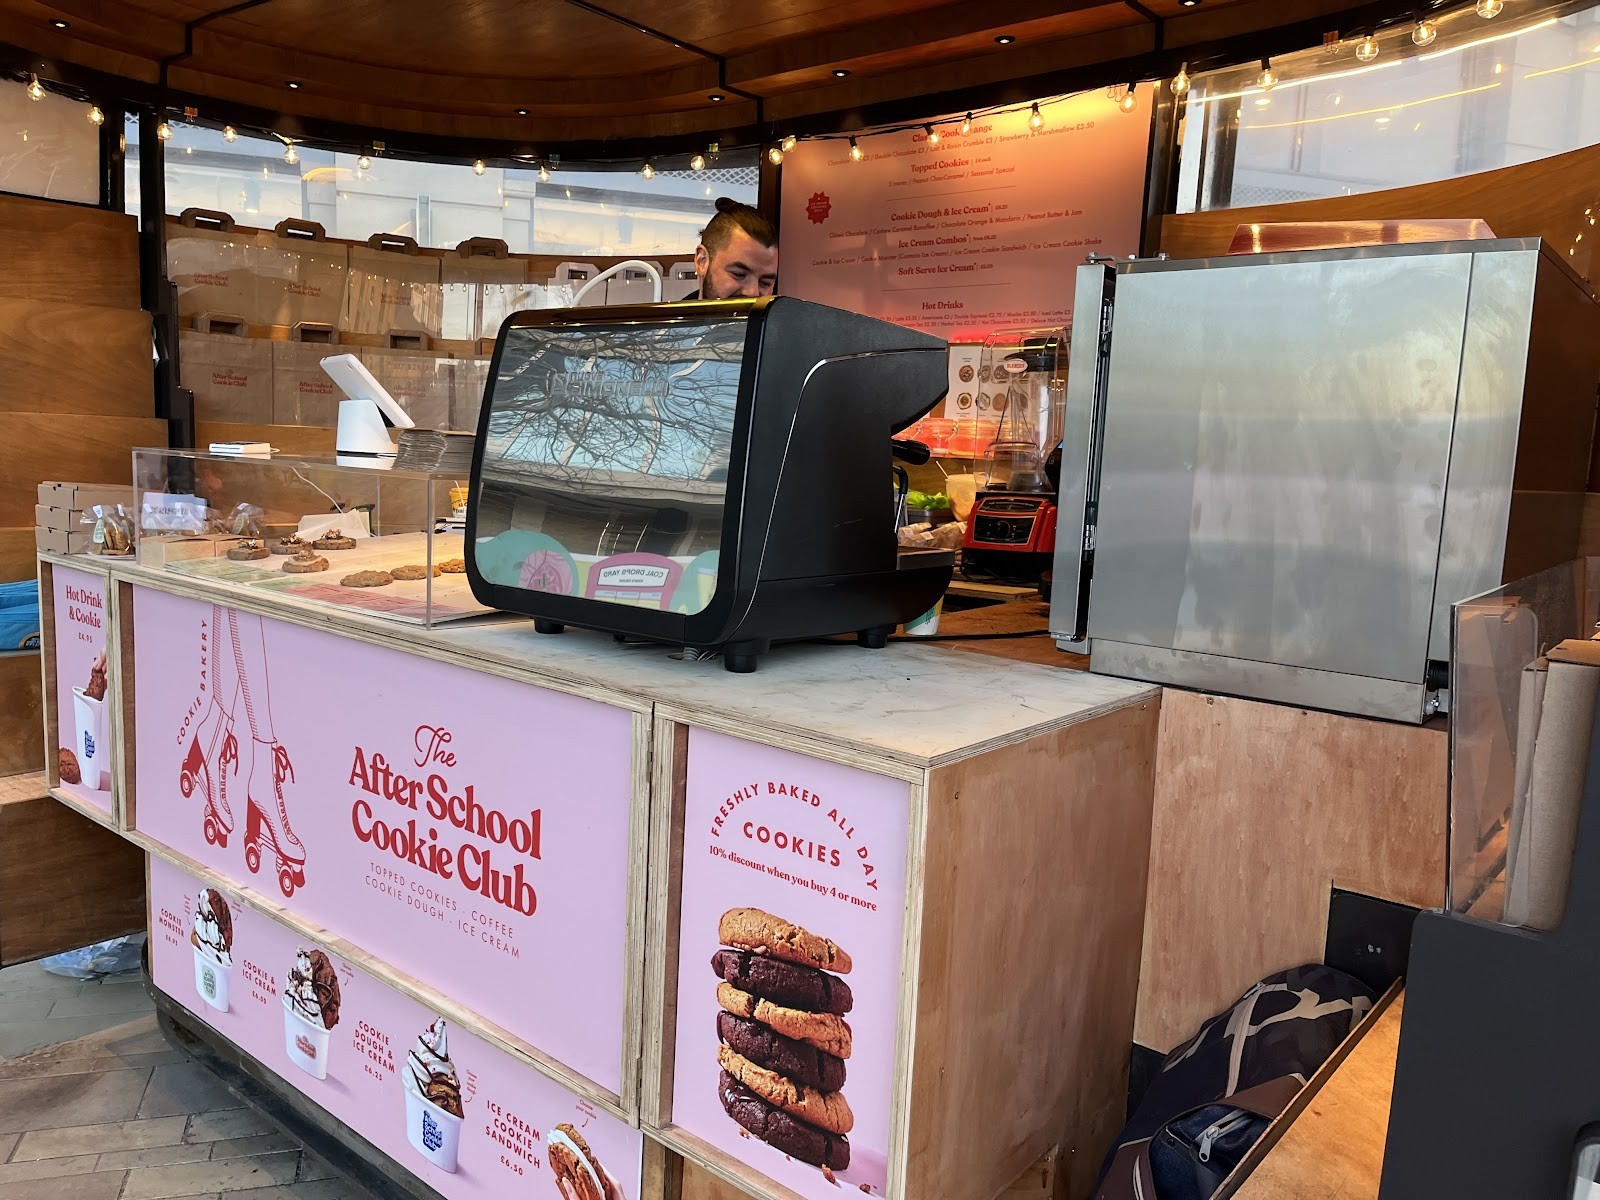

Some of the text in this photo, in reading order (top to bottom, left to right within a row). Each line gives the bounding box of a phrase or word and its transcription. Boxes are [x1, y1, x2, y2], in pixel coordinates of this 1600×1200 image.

[999, 133, 1030, 143] Strawberry
[1037, 125, 1075, 136] Marshmallow
[1076, 121, 1095, 131] £3.50
[910, 161, 938, 173] Topped
[938, 158, 969, 169] Cookies
[970, 168, 994, 177] Seasonal
[995, 166, 1015, 175] Special
[845, 229, 868, 237] Chocolate
[940, 220, 966, 229] Chocolate
[967, 219, 988, 227] Orange
[1027, 213, 1046, 221] Peanut
[1046, 211, 1063, 219] Butter
[1070, 208, 1083, 216] Jam
[890, 211, 917, 222] Cookie
[917, 208, 942, 220] Dough
[943, 208, 950, 216] &
[951, 206, 962, 216] Ice
[898, 240, 909, 248] Ice
[910, 238, 935, 247] Cream
[1000, 244, 1027, 252] Sandwich
[1042, 241, 1061, 249] Cream
[1062, 240, 1083, 248] Cookie
[1084, 238, 1102, 246] Shake
[898, 266, 914, 275] Soft
[914, 265, 936, 274] Serve
[937, 264, 948, 273] Ice
[922, 300, 964, 310] Hot Drinks
[65, 584, 80, 602] Hot
[69, 605, 102, 629] & Cookie
[78, 632, 93, 643] £4.95
[176, 619, 209, 746] COOKIE BAKERY
[413, 724, 457, 768] The
[348, 746, 542, 861] After School
[711, 781, 878, 891] FRESHLY BAKED ALL DAY
[743, 821, 841, 867] COOKIES
[351, 799, 538, 917] Cookie Club
[708, 844, 878, 912] 10% discount when you buy 4 or more
[369, 862, 514, 939] TOPPED COOKIES COFFEE
[159, 916, 184, 938] MONSTER
[160, 908, 182, 927] COOKIE
[364, 874, 521, 959] COOKIE DOUGH ICE CREAM
[242, 968, 277, 997] ICE CREAM
[243, 959, 276, 985] COOKIE &
[355, 1029, 393, 1060] DOUGH &
[358, 1020, 390, 1046] COOKIE
[352, 1039, 396, 1074] ICE CREAM
[364, 1064, 383, 1081] £6.25
[487, 1099, 540, 1142] ICE CREAM
[485, 1125, 541, 1169] SANDWICH
[493, 1118, 533, 1150] COOKIE
[500, 1155, 524, 1176] £6.50
